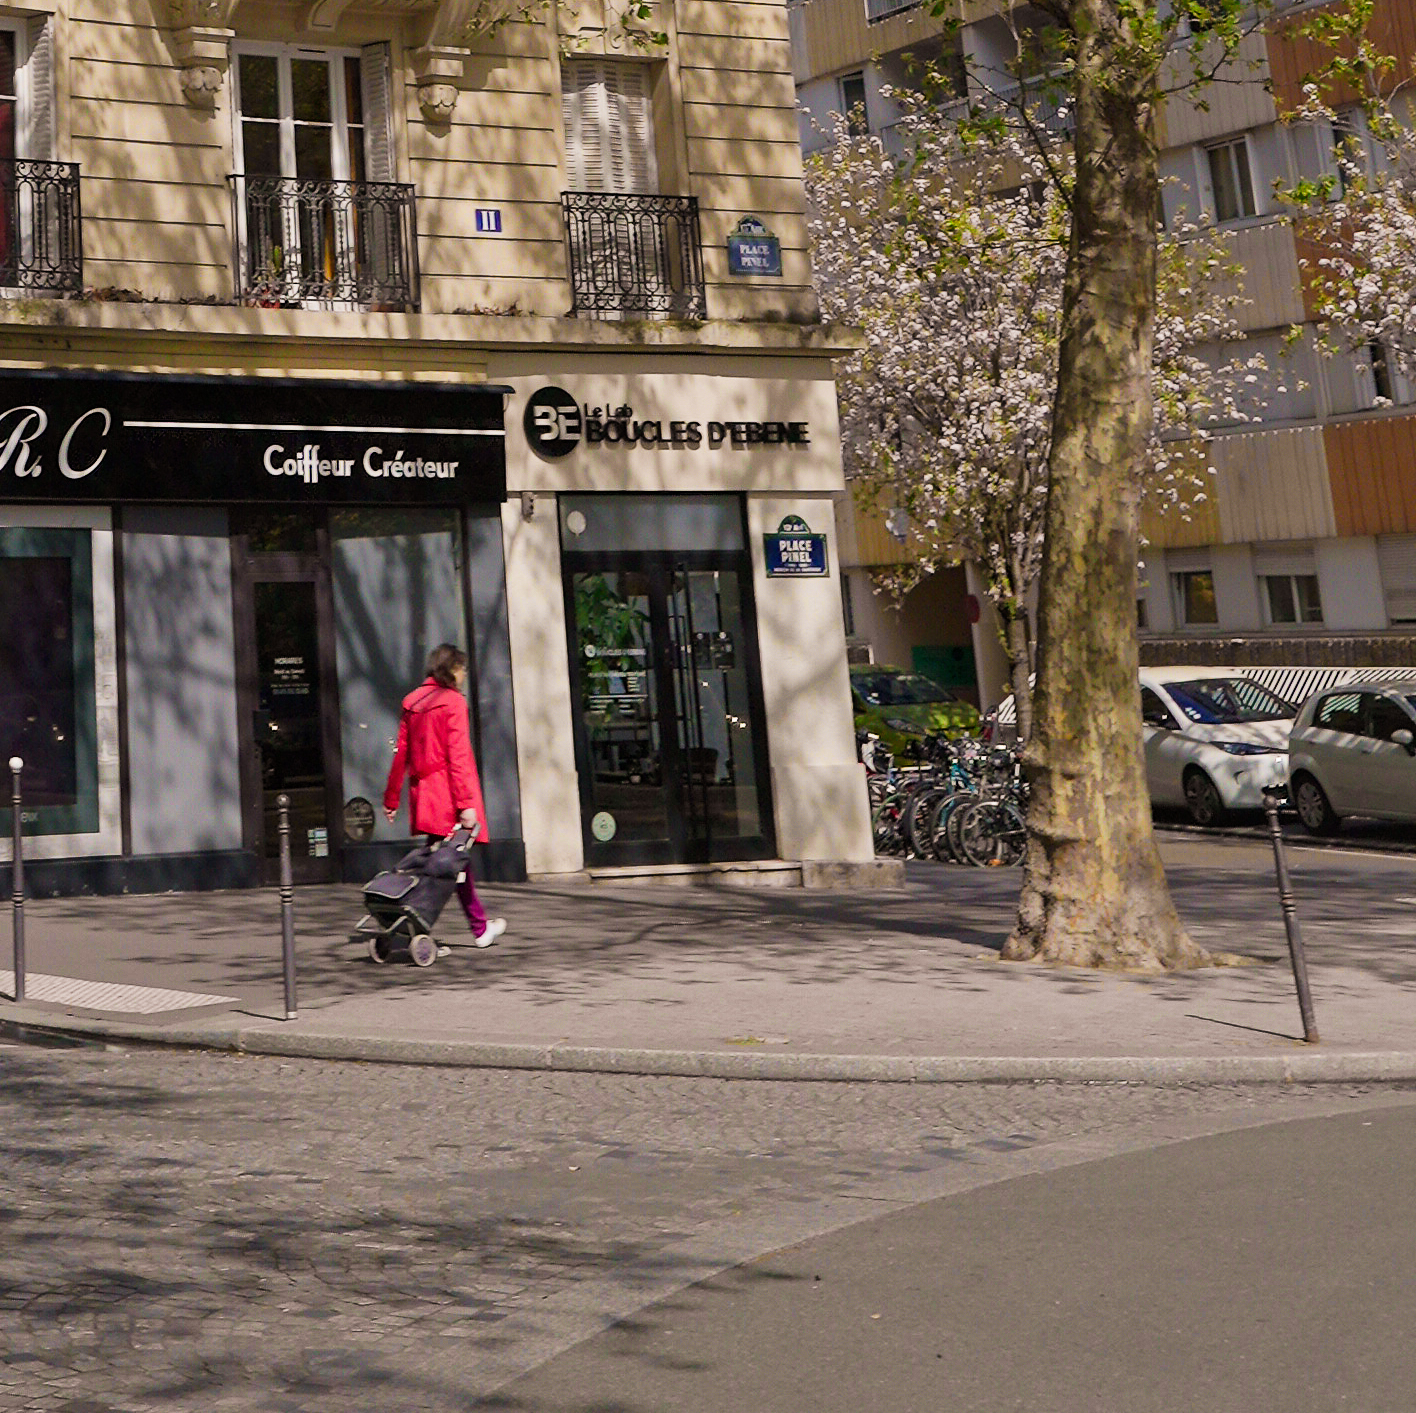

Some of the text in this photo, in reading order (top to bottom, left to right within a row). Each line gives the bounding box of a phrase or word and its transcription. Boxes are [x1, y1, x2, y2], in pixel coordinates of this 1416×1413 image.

[739, 244, 770, 254] PLACE
[584, 402, 633, 419] Le Lab
[585, 419, 811, 444] BOUCLES D'EBENE
[263, 444, 459, 484] Coiffeur Créateur
[778, 539, 813, 551] PLACE
[781, 552, 812, 562] PINEL
